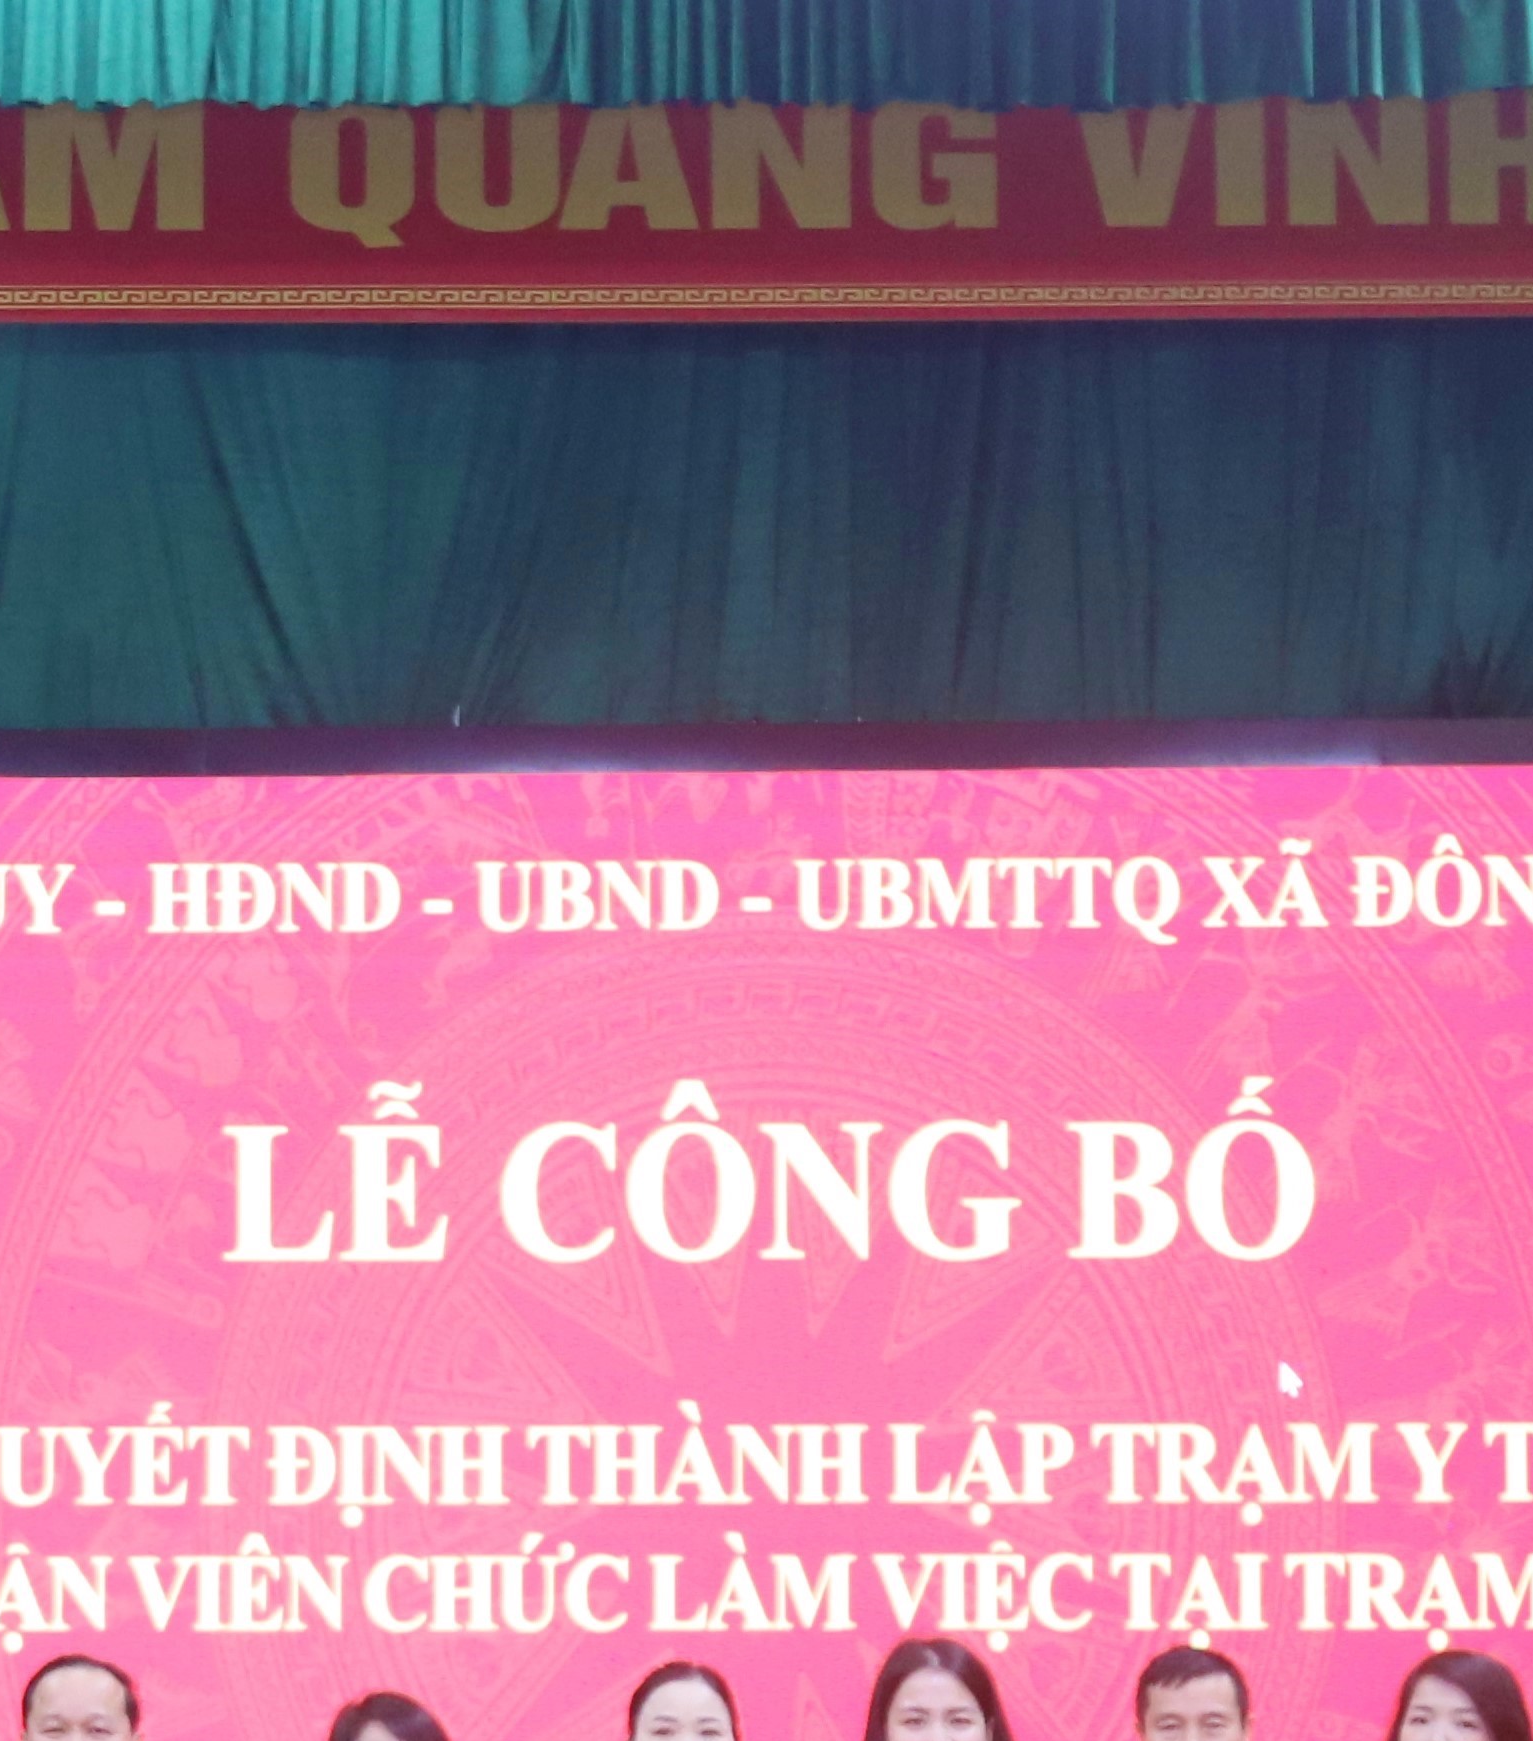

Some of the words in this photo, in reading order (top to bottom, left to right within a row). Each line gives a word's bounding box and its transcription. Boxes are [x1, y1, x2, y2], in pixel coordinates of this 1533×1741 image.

[289, 102, 998, 247] QUANG
[94, 900, 126, 916] -
[147, 861, 401, 934] HĐND
[422, 898, 453, 915] -
[475, 859, 720, 933] UBND
[740, 896, 773, 912] -
[793, 856, 1181, 945] UBMTTQ
[1202, 838, 1329, 928] XÃ
[222, 1080, 450, 1263] LỄ
[499, 1078, 1022, 1264] CÔNG
[1066, 1076, 1317, 1261] BỐ
[267, 1422, 510, 1528] ĐỊNH
[525, 1400, 869, 1506] THÀNH
[889, 1409, 1075, 1526] LẬP
[1090, 1422, 1379, 1526] TRẠM
[1396, 1422, 1469, 1503] Y
[128, 1533, 350, 1633] VIÊN
[364, 1531, 630, 1634] CHỨC
[649, 1531, 857, 1631] LÀM
[873, 1540, 1095, 1653] VIỆC
[1109, 1552, 1269, 1650] TẠI
